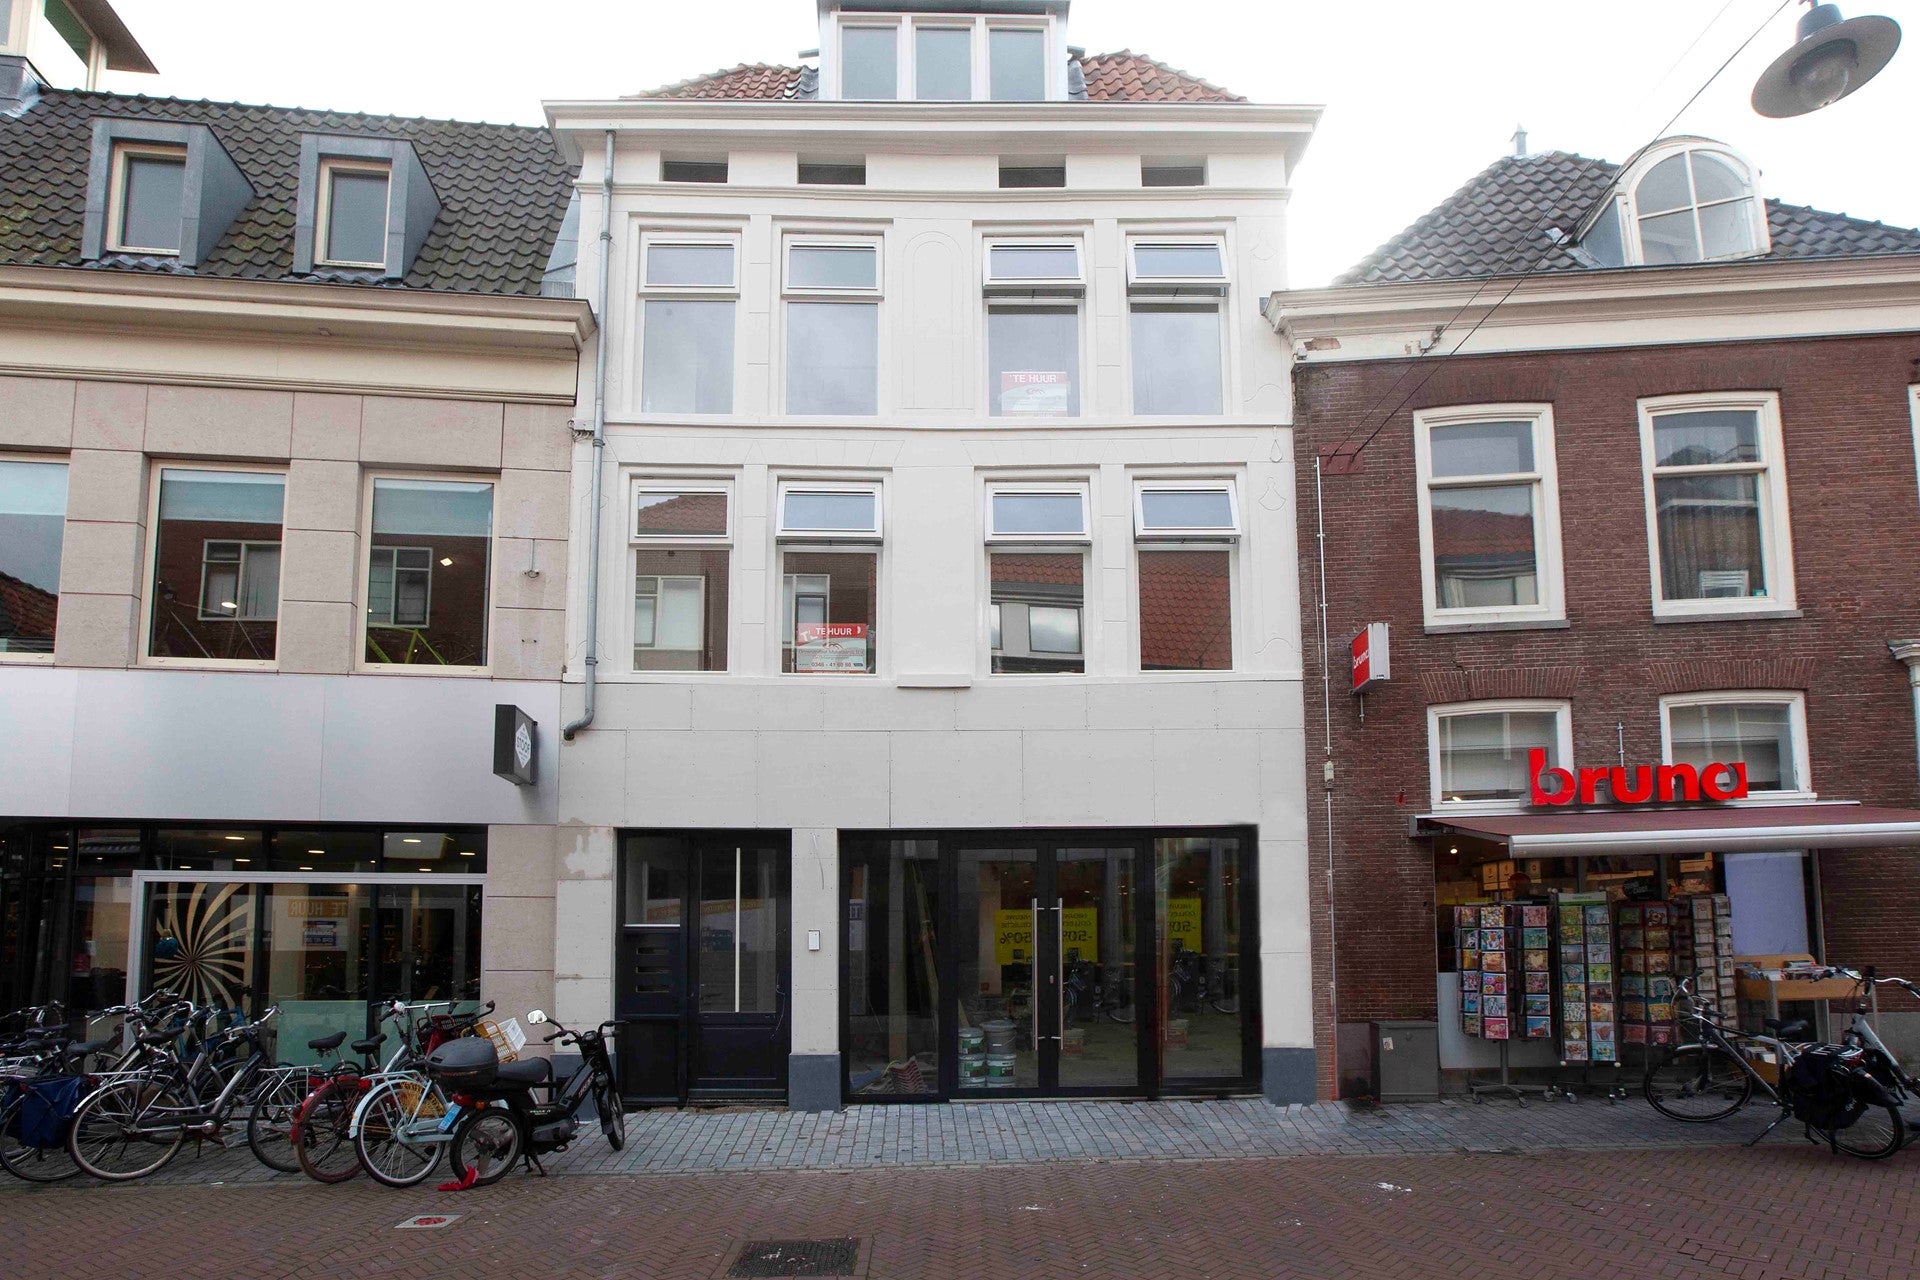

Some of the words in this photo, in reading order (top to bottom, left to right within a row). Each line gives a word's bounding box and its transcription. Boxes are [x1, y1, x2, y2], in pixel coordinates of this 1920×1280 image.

[1013, 374, 1026, 383] TE
[1029, 374, 1057, 383] HUUR
[816, 627, 826, 635] TE
[828, 627, 852, 636] HUUR
[1353, 649, 1369, 670] bruna
[1528, 747, 1748, 806] bruna
